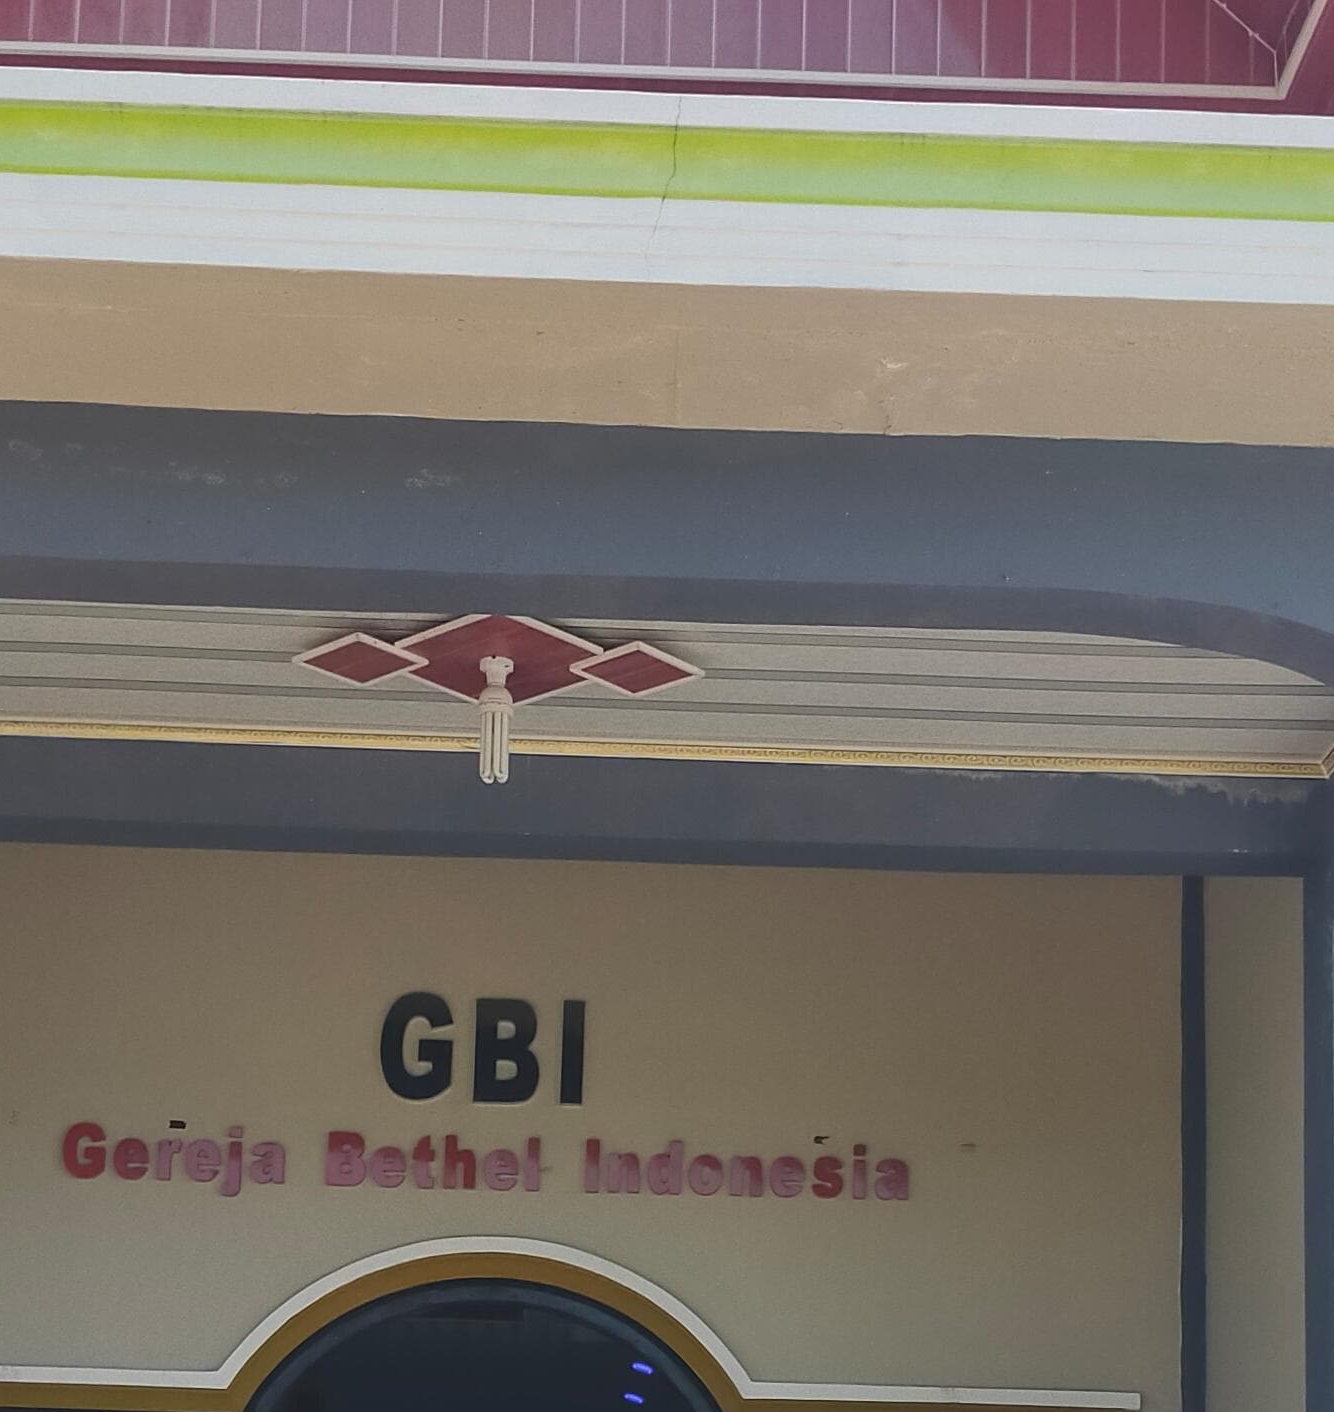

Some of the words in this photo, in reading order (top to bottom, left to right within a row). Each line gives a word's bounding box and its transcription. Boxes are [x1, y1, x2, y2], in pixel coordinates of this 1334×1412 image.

[378, 990, 588, 1106] GBI
[62, 1122, 286, 1198] Gereja
[325, 1131, 542, 1192] Bethel
[584, 1141, 912, 1201] Indonesia
